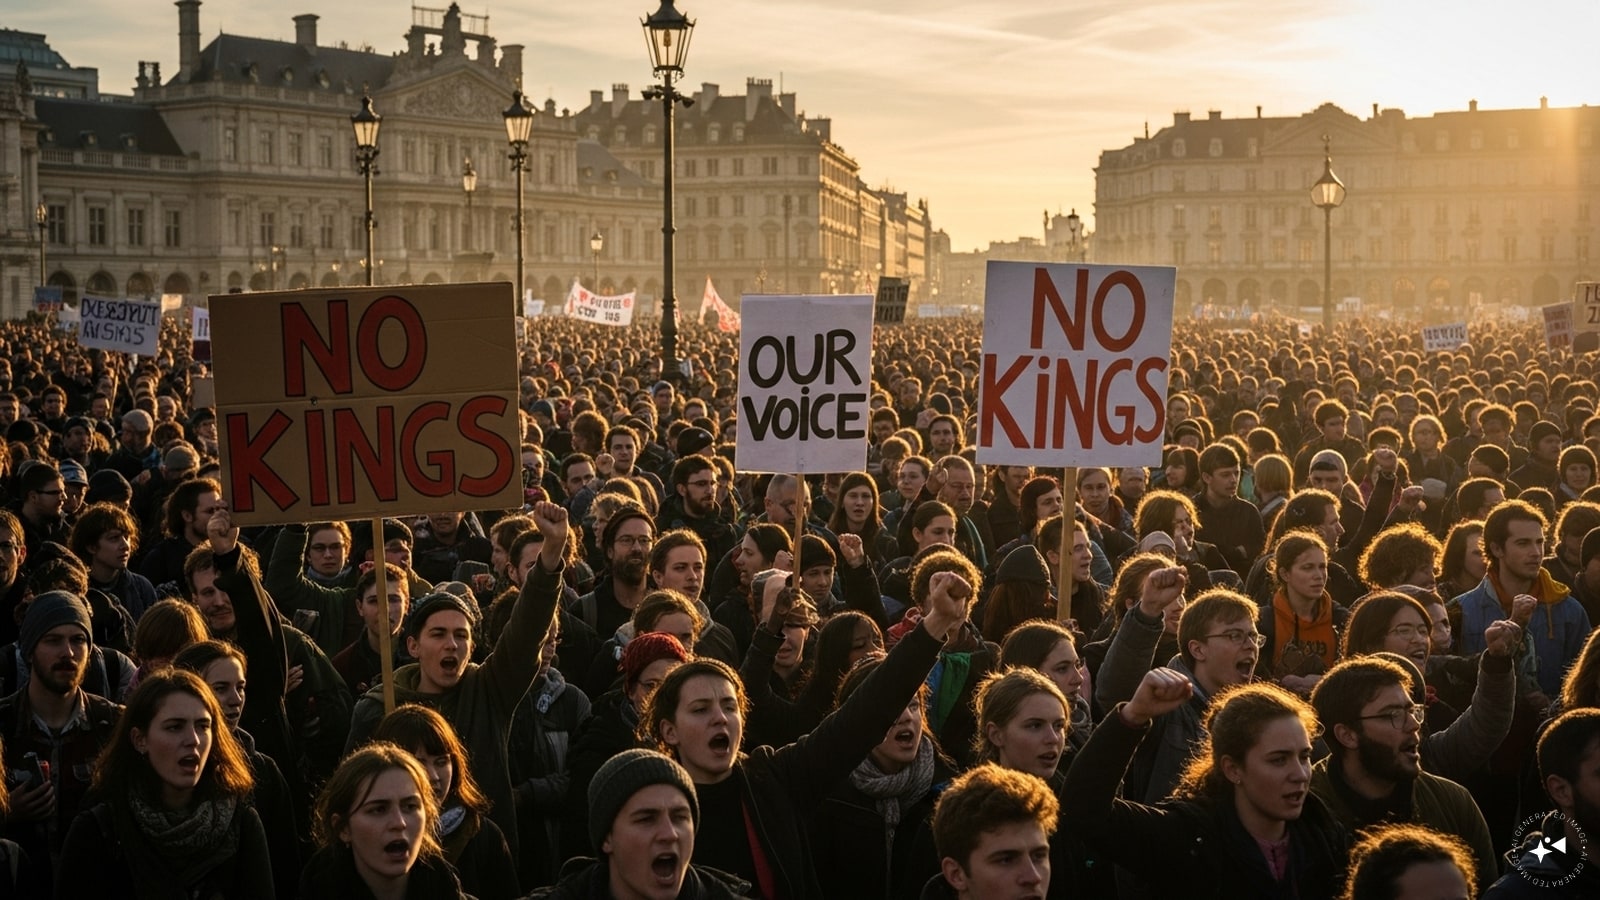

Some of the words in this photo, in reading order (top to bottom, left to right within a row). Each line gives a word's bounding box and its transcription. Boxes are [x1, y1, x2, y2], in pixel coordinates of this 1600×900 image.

[280, 295, 428, 397] NO
[1030, 267, 1146, 353] NO
[748, 328, 862, 389] OUR
[226, 395, 515, 512] KINGS
